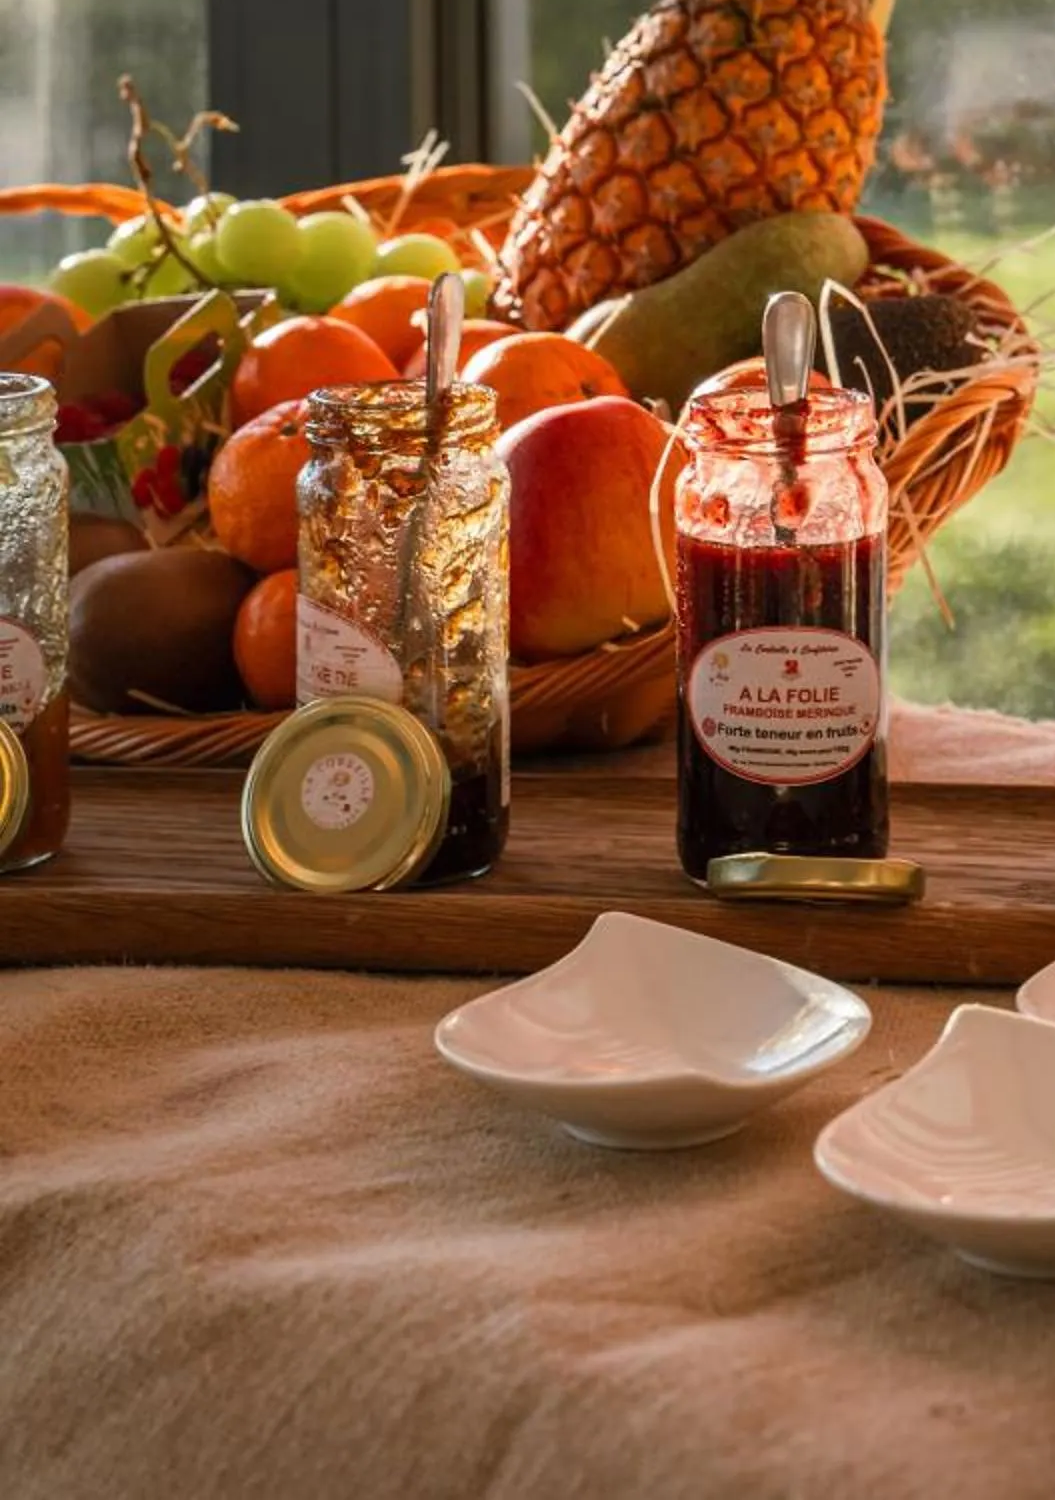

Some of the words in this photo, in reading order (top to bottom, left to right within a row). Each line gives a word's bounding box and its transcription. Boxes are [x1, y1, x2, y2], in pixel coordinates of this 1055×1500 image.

[739, 687, 752, 701] A
[757, 687, 781, 704] LA
[786, 686, 841, 704] FOLIE
[723, 703, 794, 719] FRAMBOISE
[717, 722, 752, 739] Forte
[755, 726, 803, 741] teneur
[806, 727, 824, 739] en
[826, 723, 859, 739] fruits
